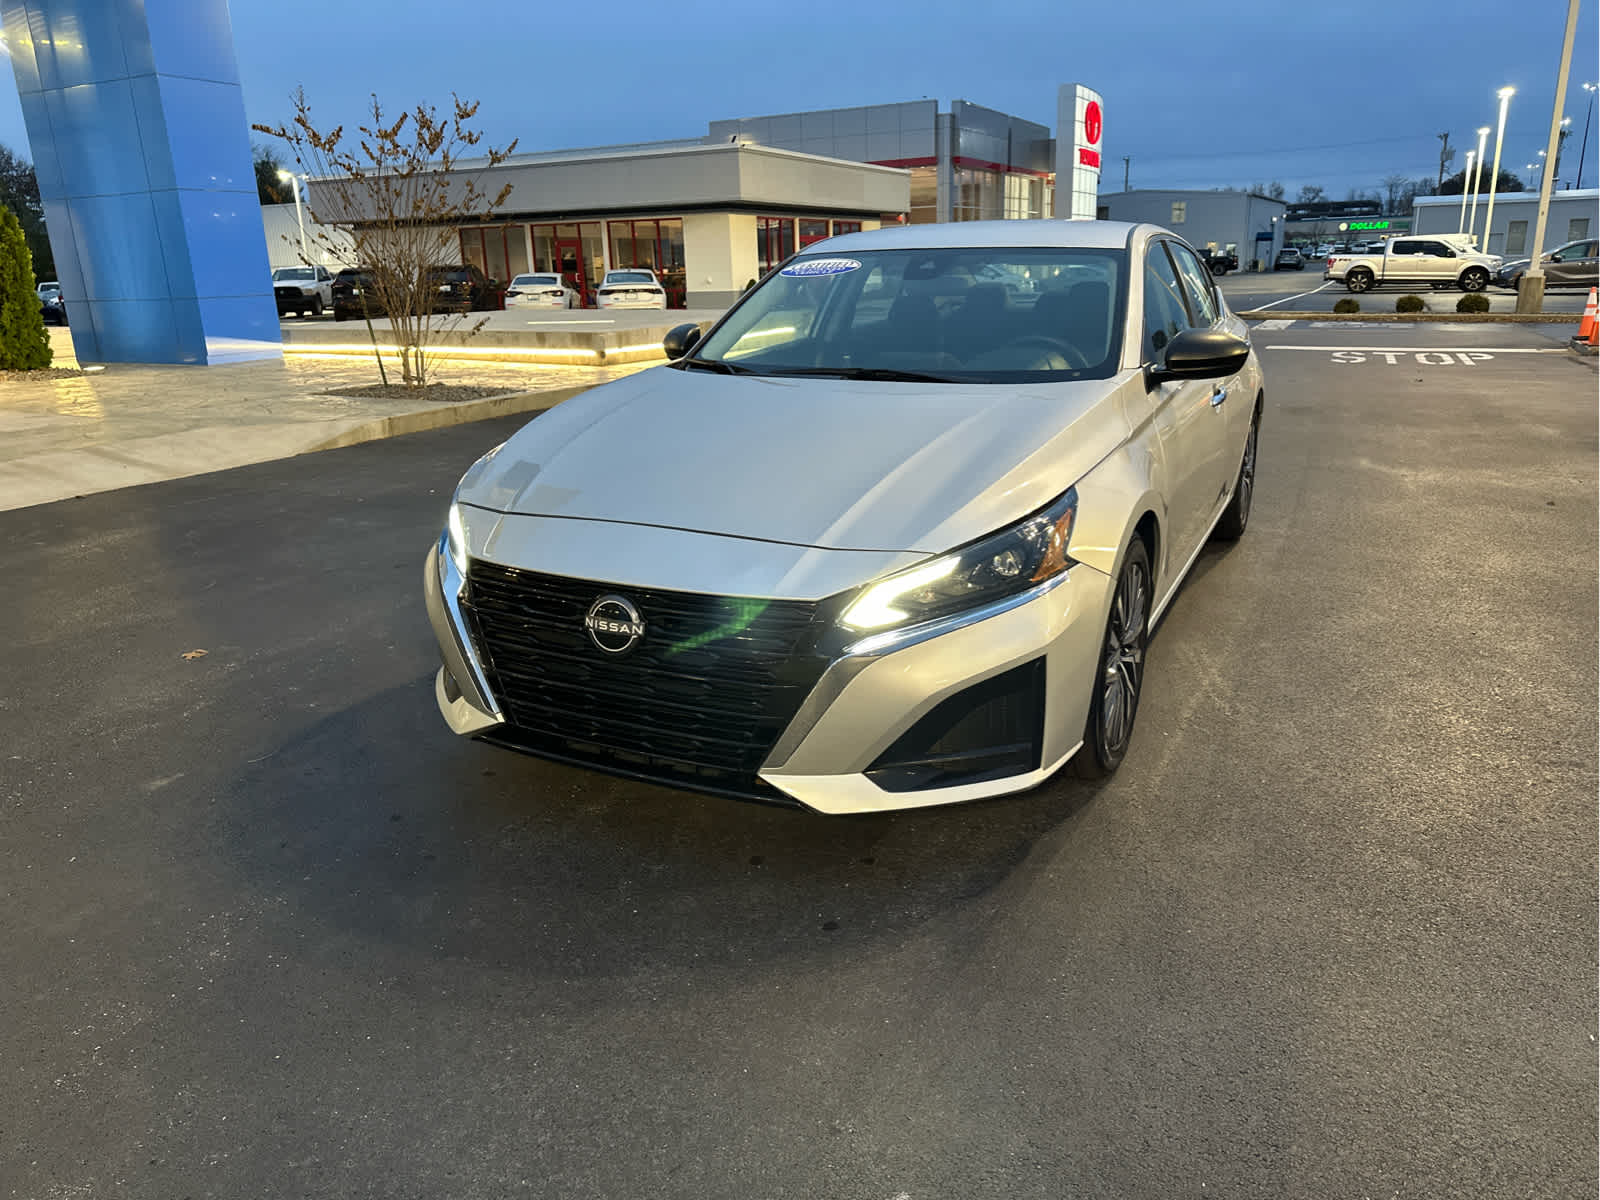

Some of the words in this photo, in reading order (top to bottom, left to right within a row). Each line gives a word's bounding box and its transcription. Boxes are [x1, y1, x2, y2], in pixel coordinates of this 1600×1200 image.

[1349, 221, 1390, 231] DOLLAR
[1331, 351, 1495, 366] STOP
[585, 616, 643, 635] NISSAN
